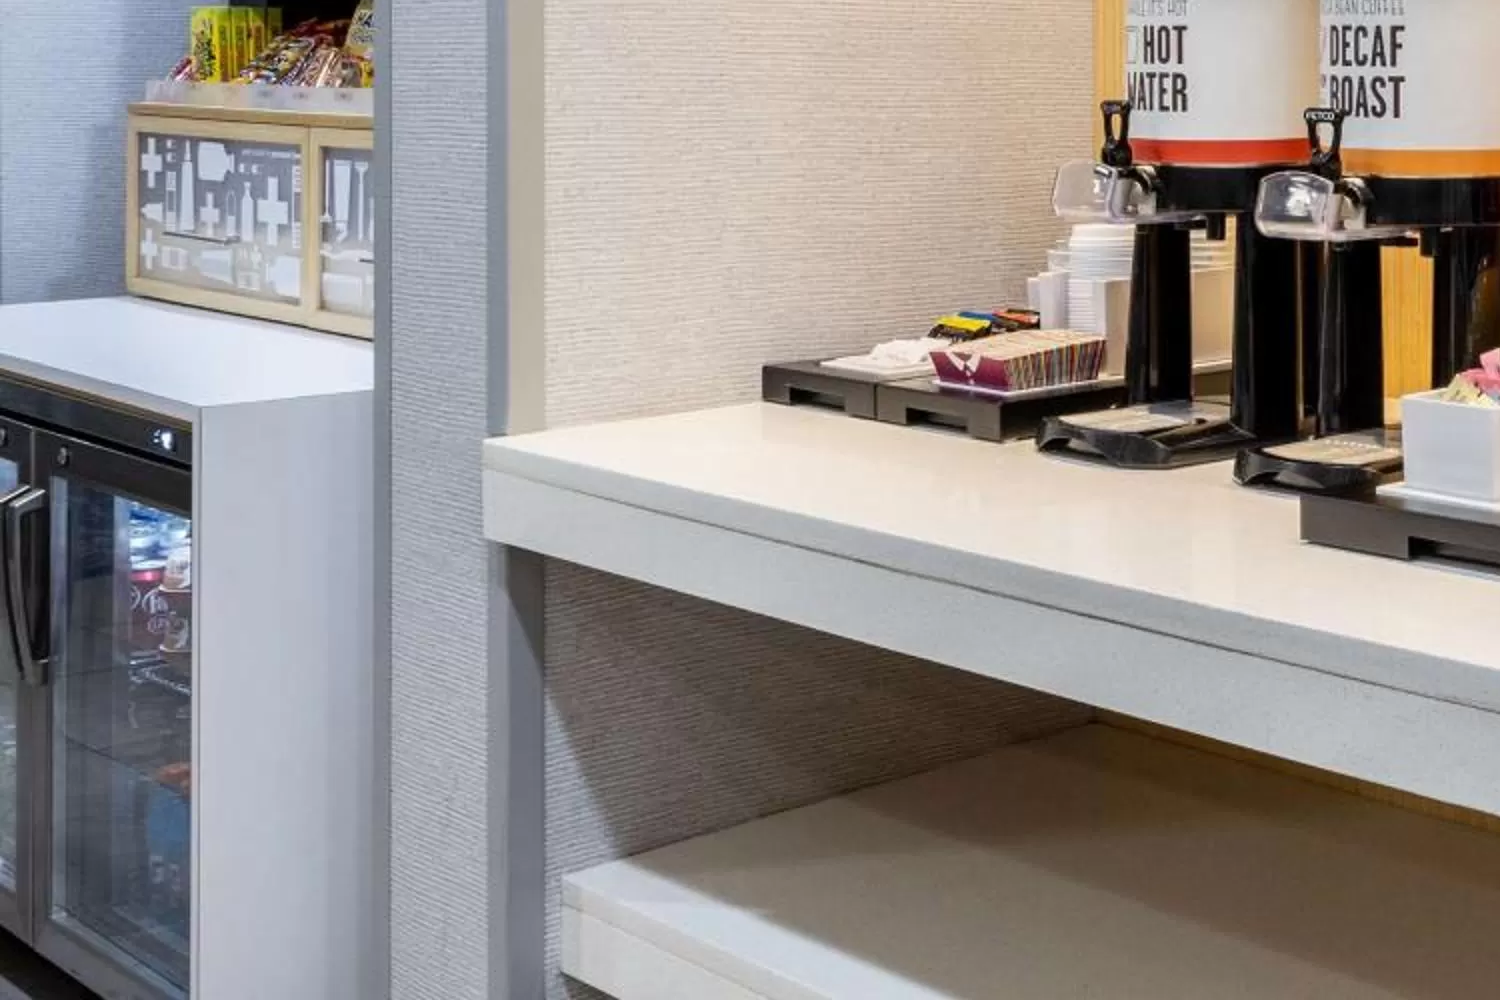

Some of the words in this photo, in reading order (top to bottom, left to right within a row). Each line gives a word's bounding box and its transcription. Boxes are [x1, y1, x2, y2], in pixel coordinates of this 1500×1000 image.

[1143, 25, 1188, 64] HOT
[1329, 24, 1405, 67] DECAF
[1329, 75, 1406, 118] ROAST
